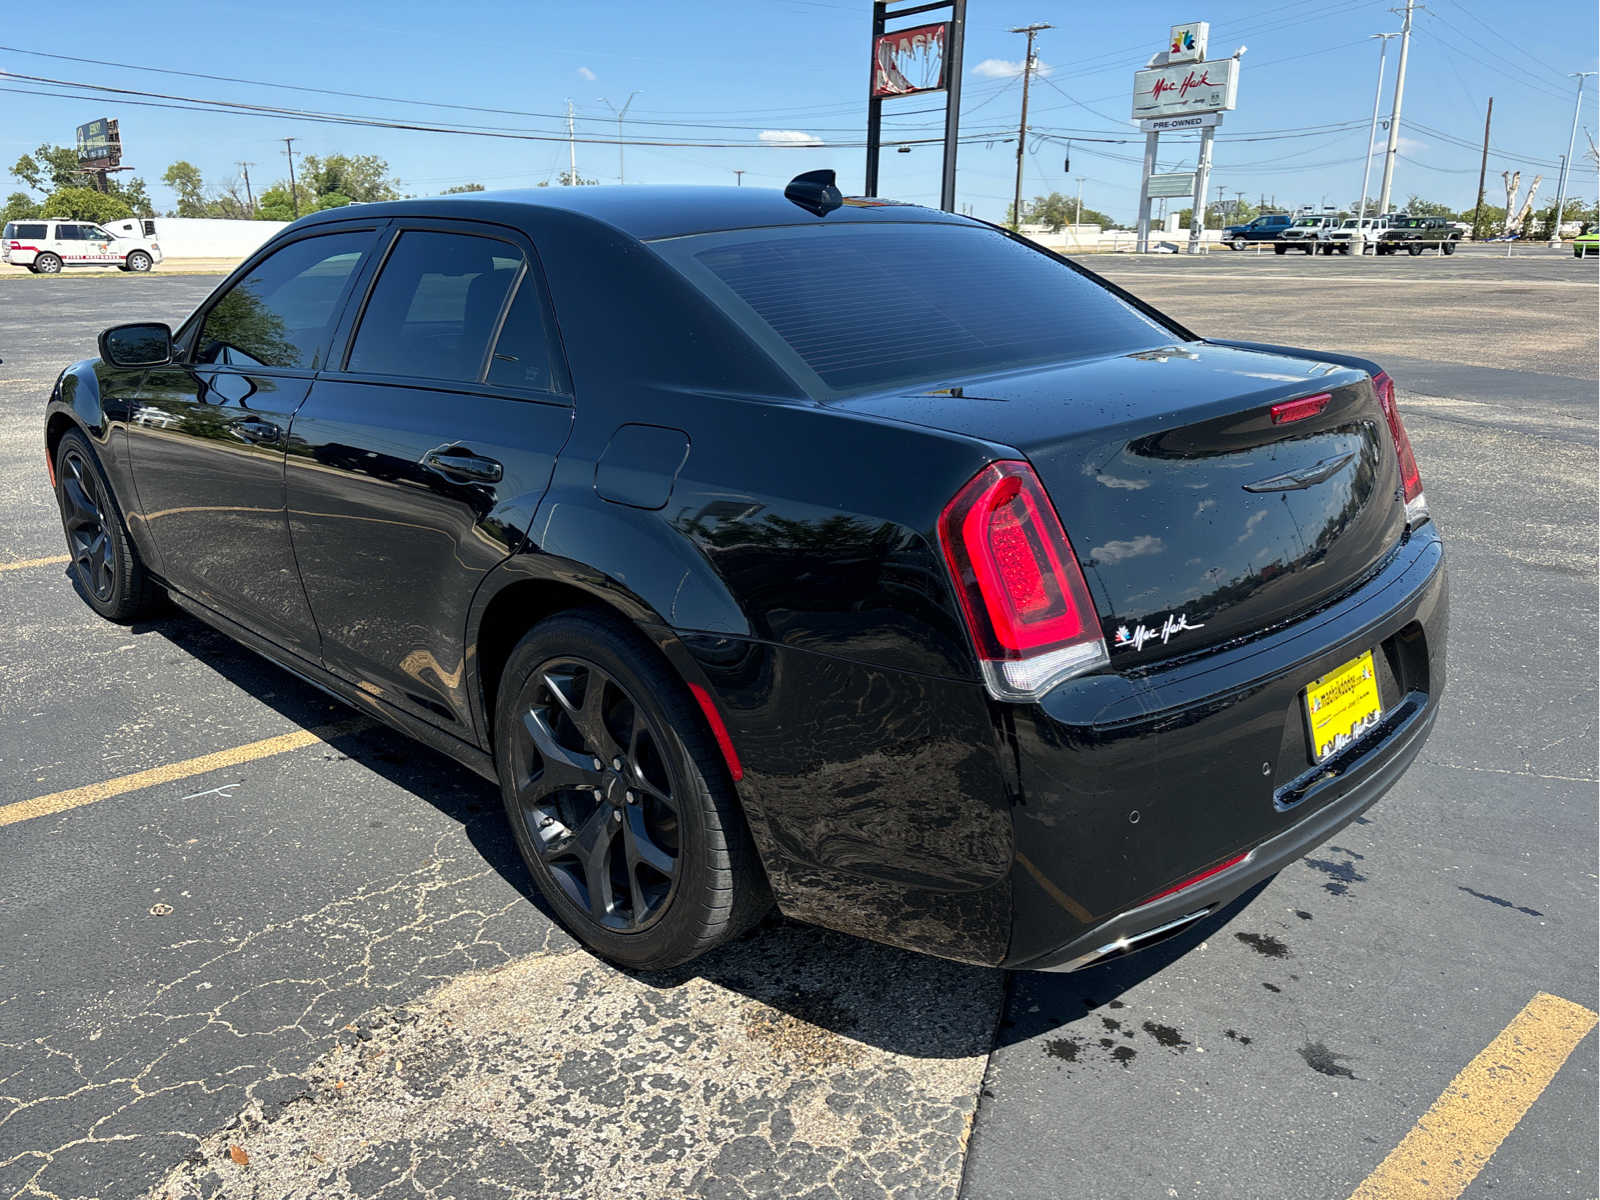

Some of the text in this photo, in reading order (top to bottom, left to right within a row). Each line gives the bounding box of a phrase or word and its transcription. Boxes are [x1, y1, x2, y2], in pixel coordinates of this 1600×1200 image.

[1148, 70, 1216, 101] Mac Haik
[1153, 117, 1202, 129] PRE-OWNED
[1130, 613, 1193, 652] Mac Haik
